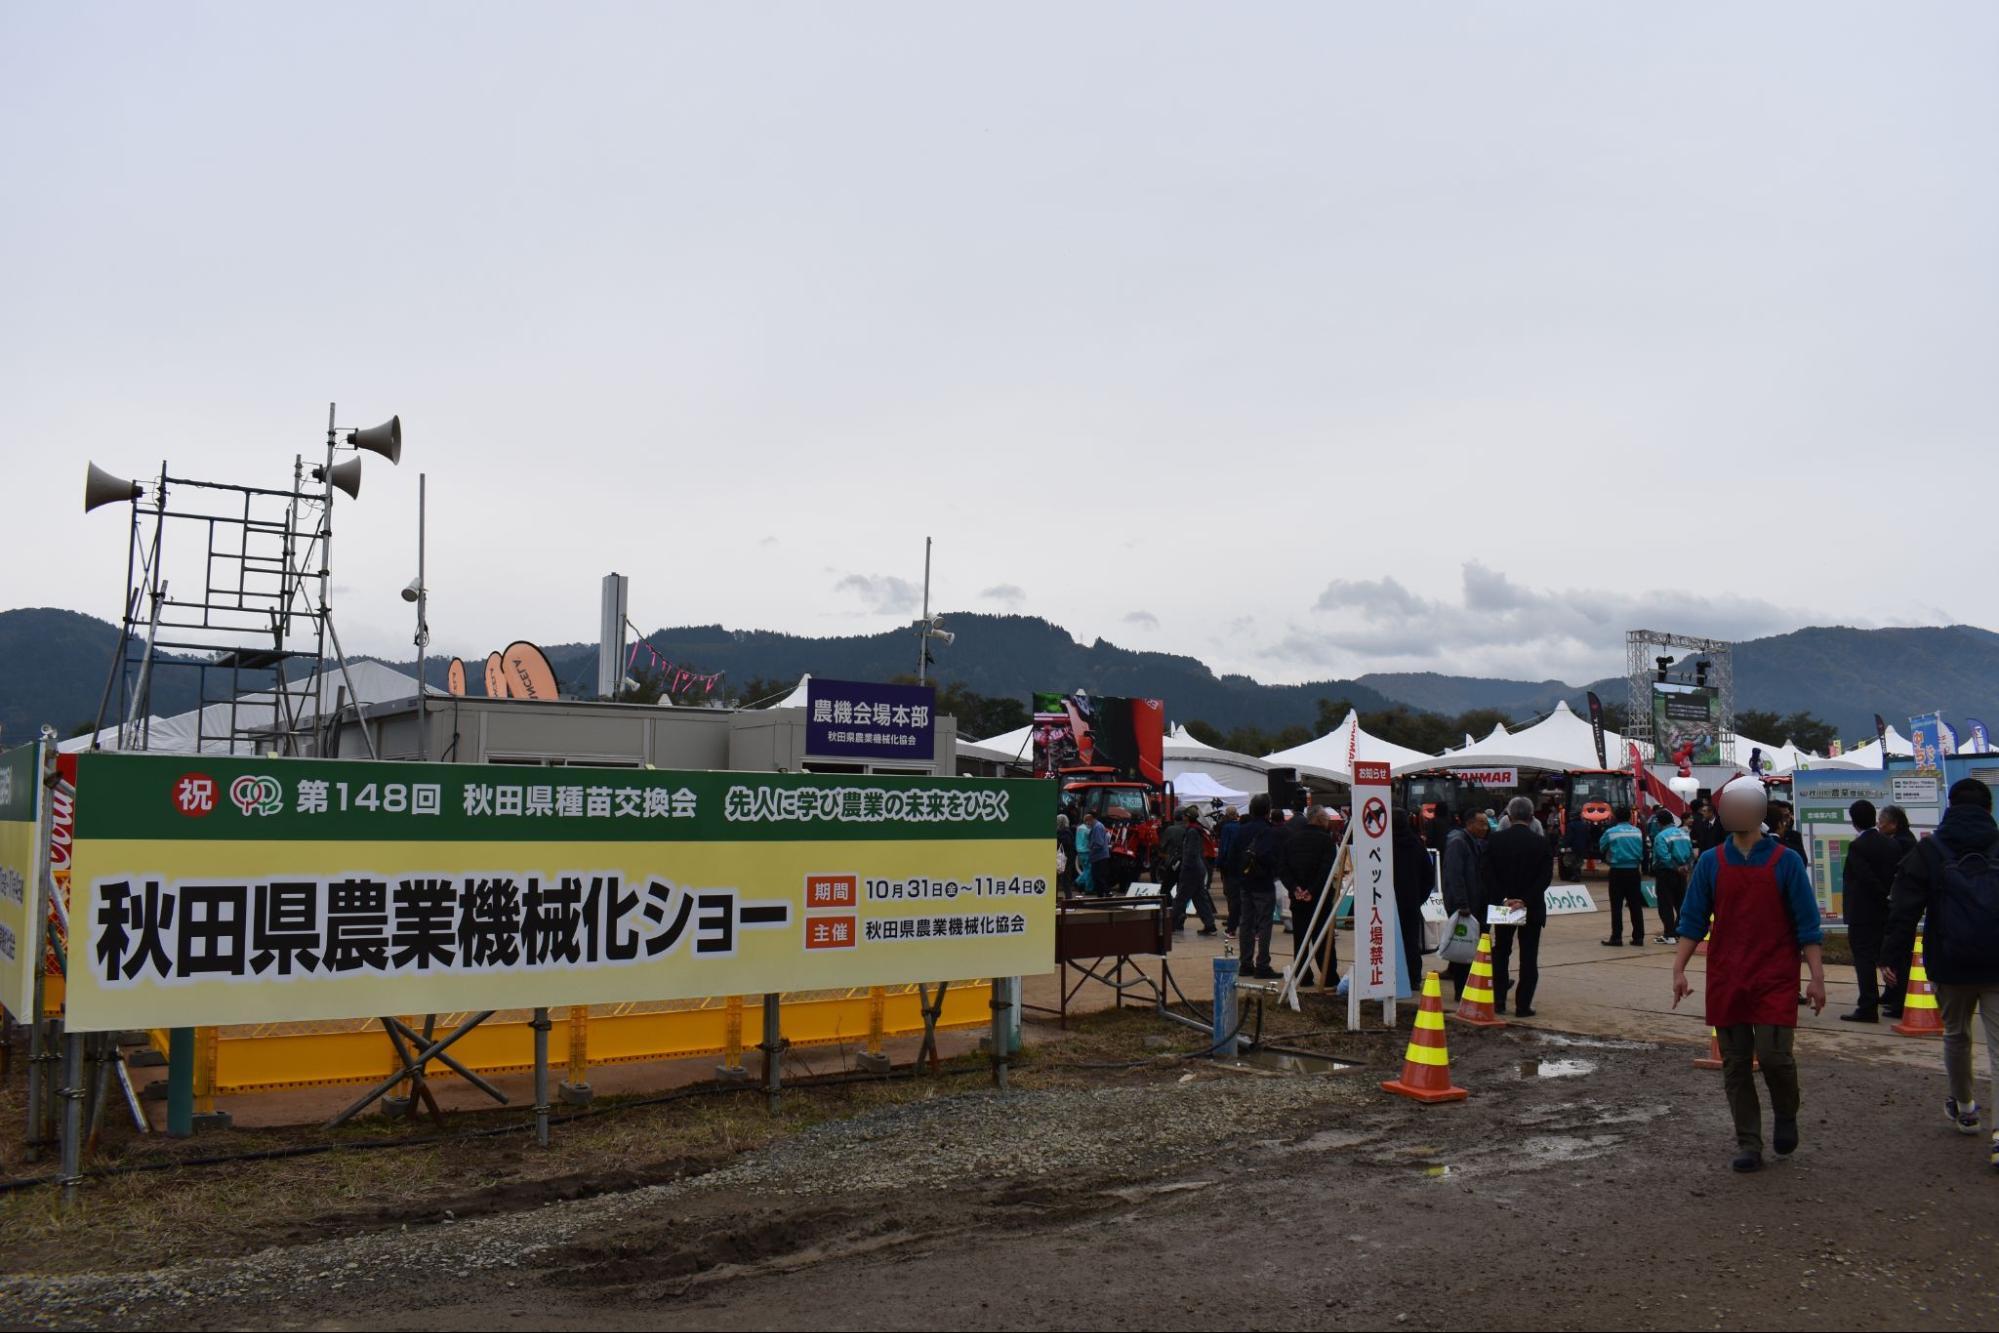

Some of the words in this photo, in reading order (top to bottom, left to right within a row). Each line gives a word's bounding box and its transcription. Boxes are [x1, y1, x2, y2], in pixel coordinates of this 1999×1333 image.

[813, 699, 929, 728] 農機会場本部
[828, 731, 916, 746] 秋田県農業機械化協会
[1359, 767, 1387, 780] お知らせ
[1456, 771, 1512, 783] ANMAR
[179, 778, 213, 811] 祝
[296, 779, 441, 815] 第148回
[463, 783, 698, 818] 秋田県種苗交換会
[725, 786, 1009, 822] 先人に学び農業の未来をひらく
[814, 882, 849, 901] 期間
[96, 877, 788, 981] 秋田県農業機械化ショー
[813, 923, 849, 942] 主催
[865, 914, 1025, 940] 秋田県農業機械化協会
[1369, 847, 1384, 985] ペット入場禁止
